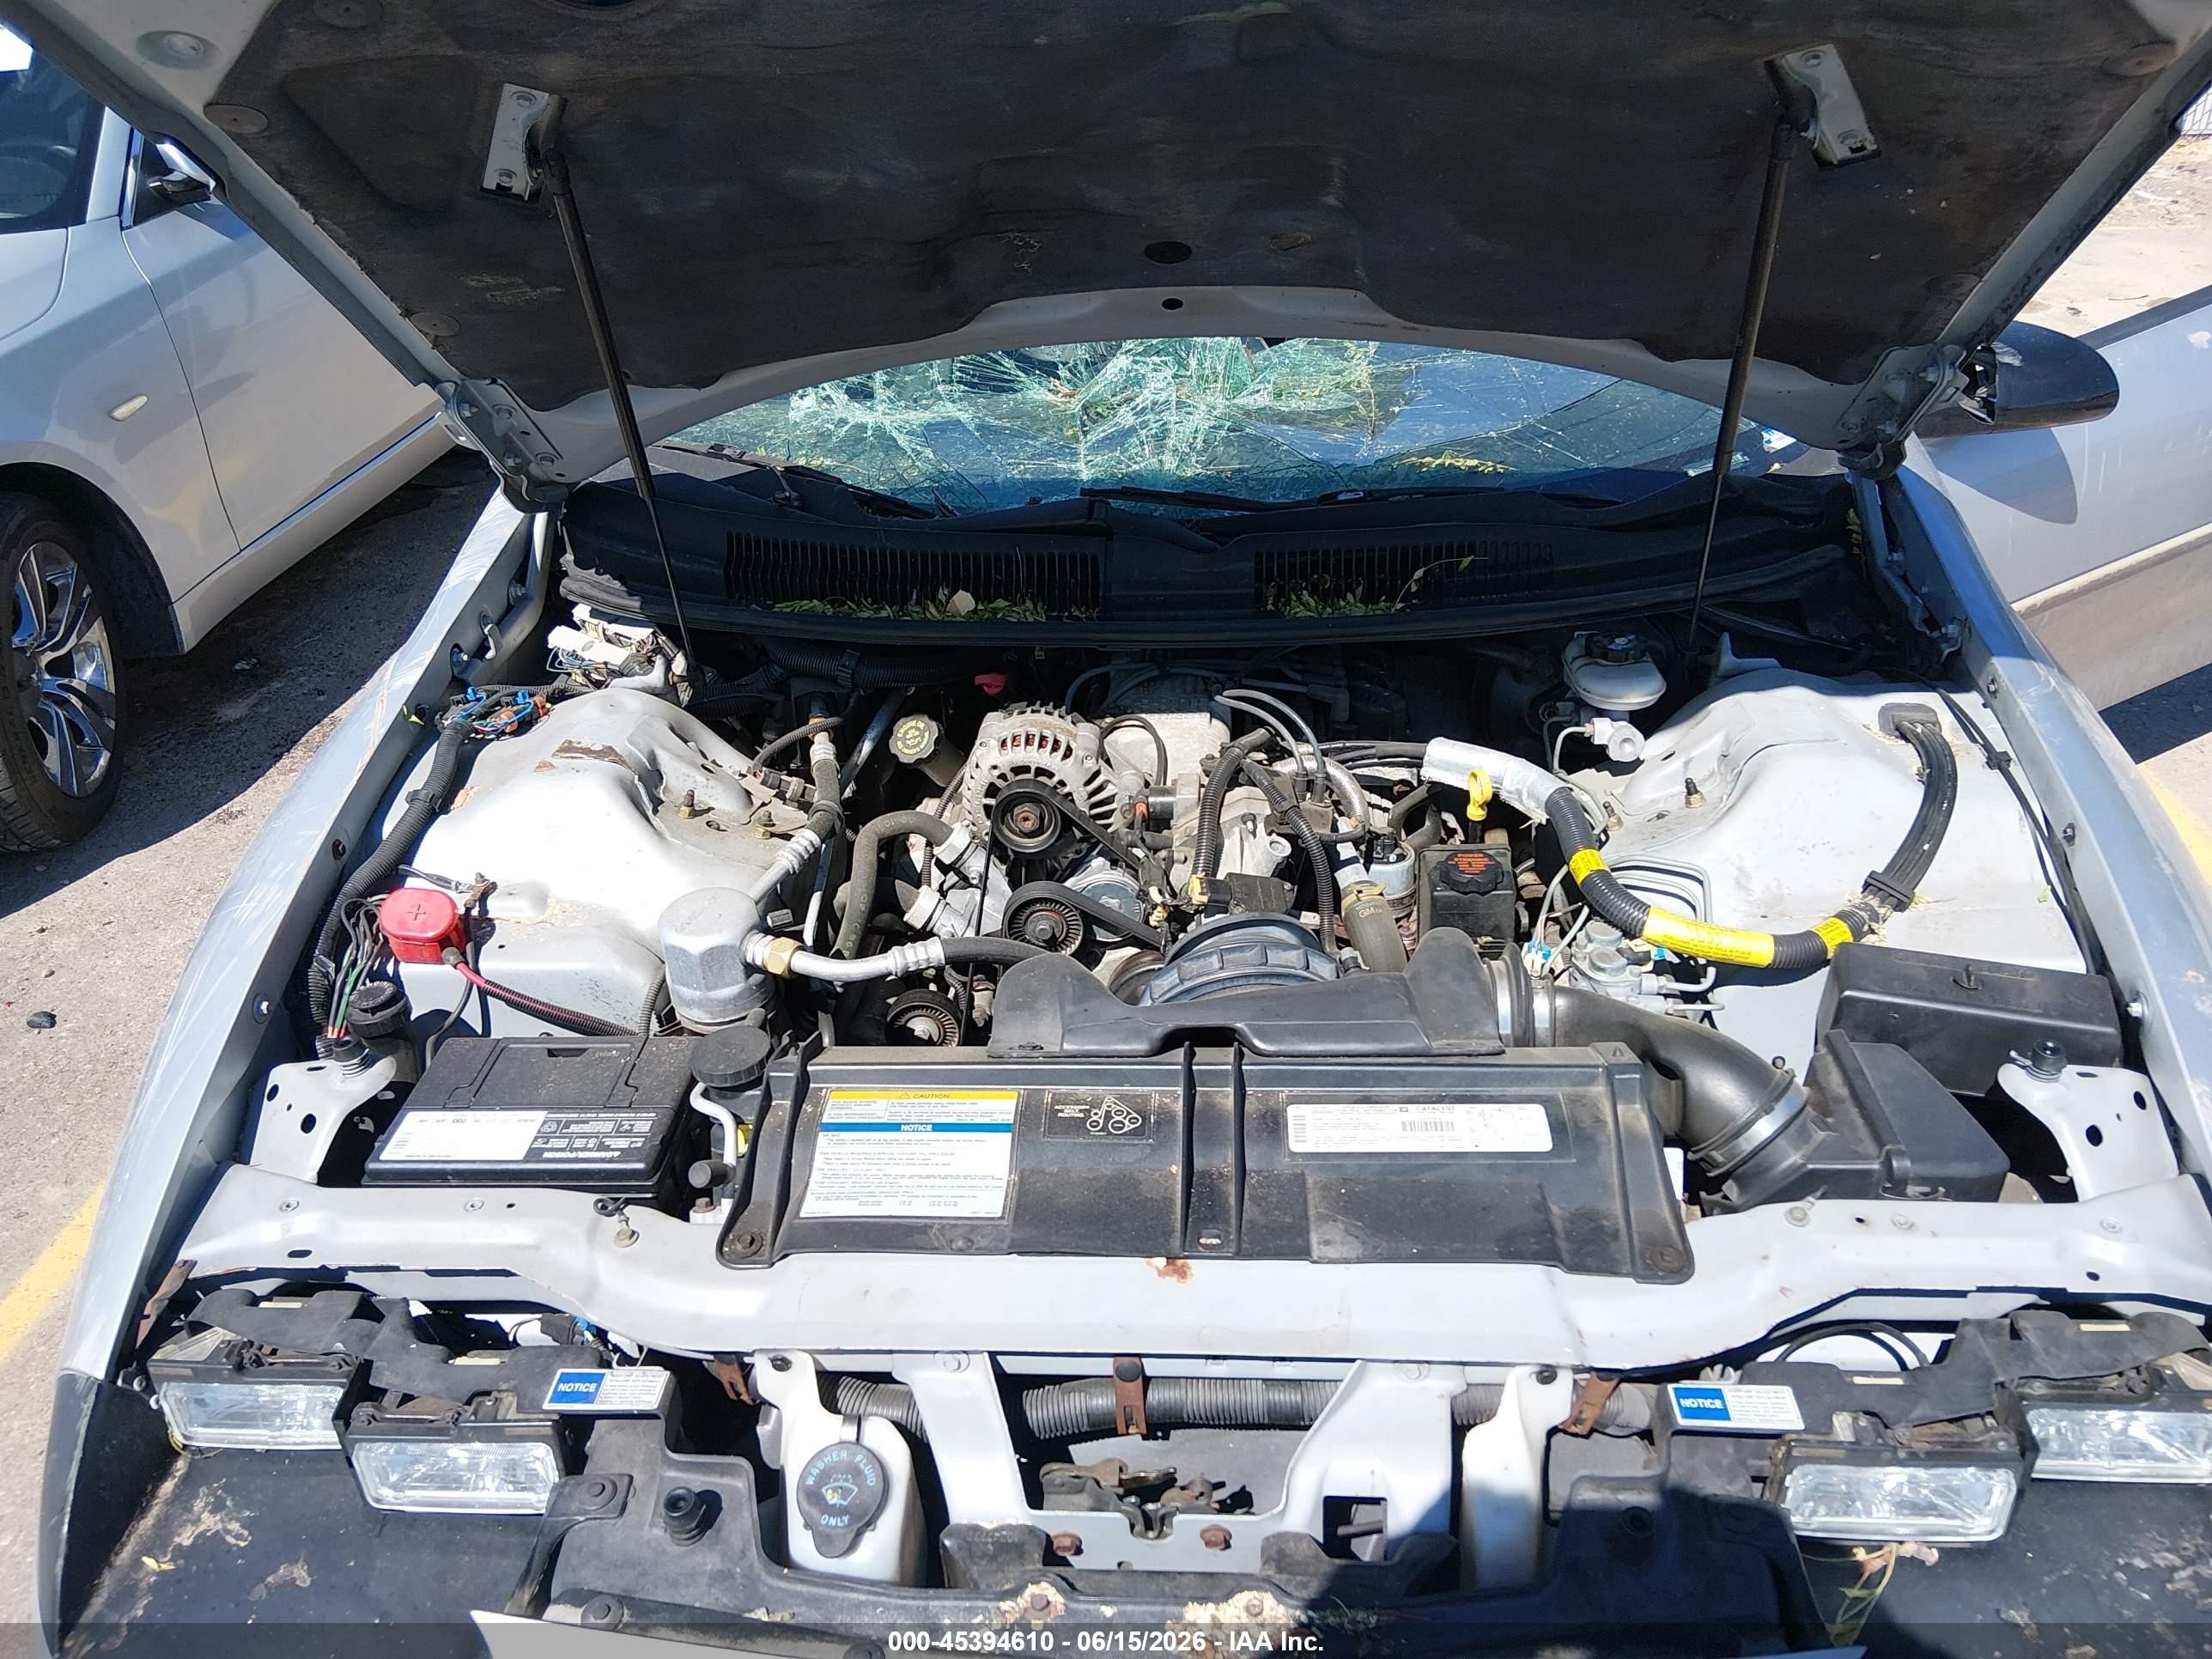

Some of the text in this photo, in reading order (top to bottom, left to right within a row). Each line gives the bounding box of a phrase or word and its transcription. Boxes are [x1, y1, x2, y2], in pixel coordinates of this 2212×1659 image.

[896, 720, 917, 738] ENGINE
[1358, 906, 1376, 918] GM
[900, 1123, 934, 1132] NOTICE
[557, 1382, 599, 1393] NOTICE
[1680, 1398, 1724, 1409] NOTICE
[805, 1449, 877, 1487] WASHER FLUID
[820, 1513, 850, 1526] ONLY
